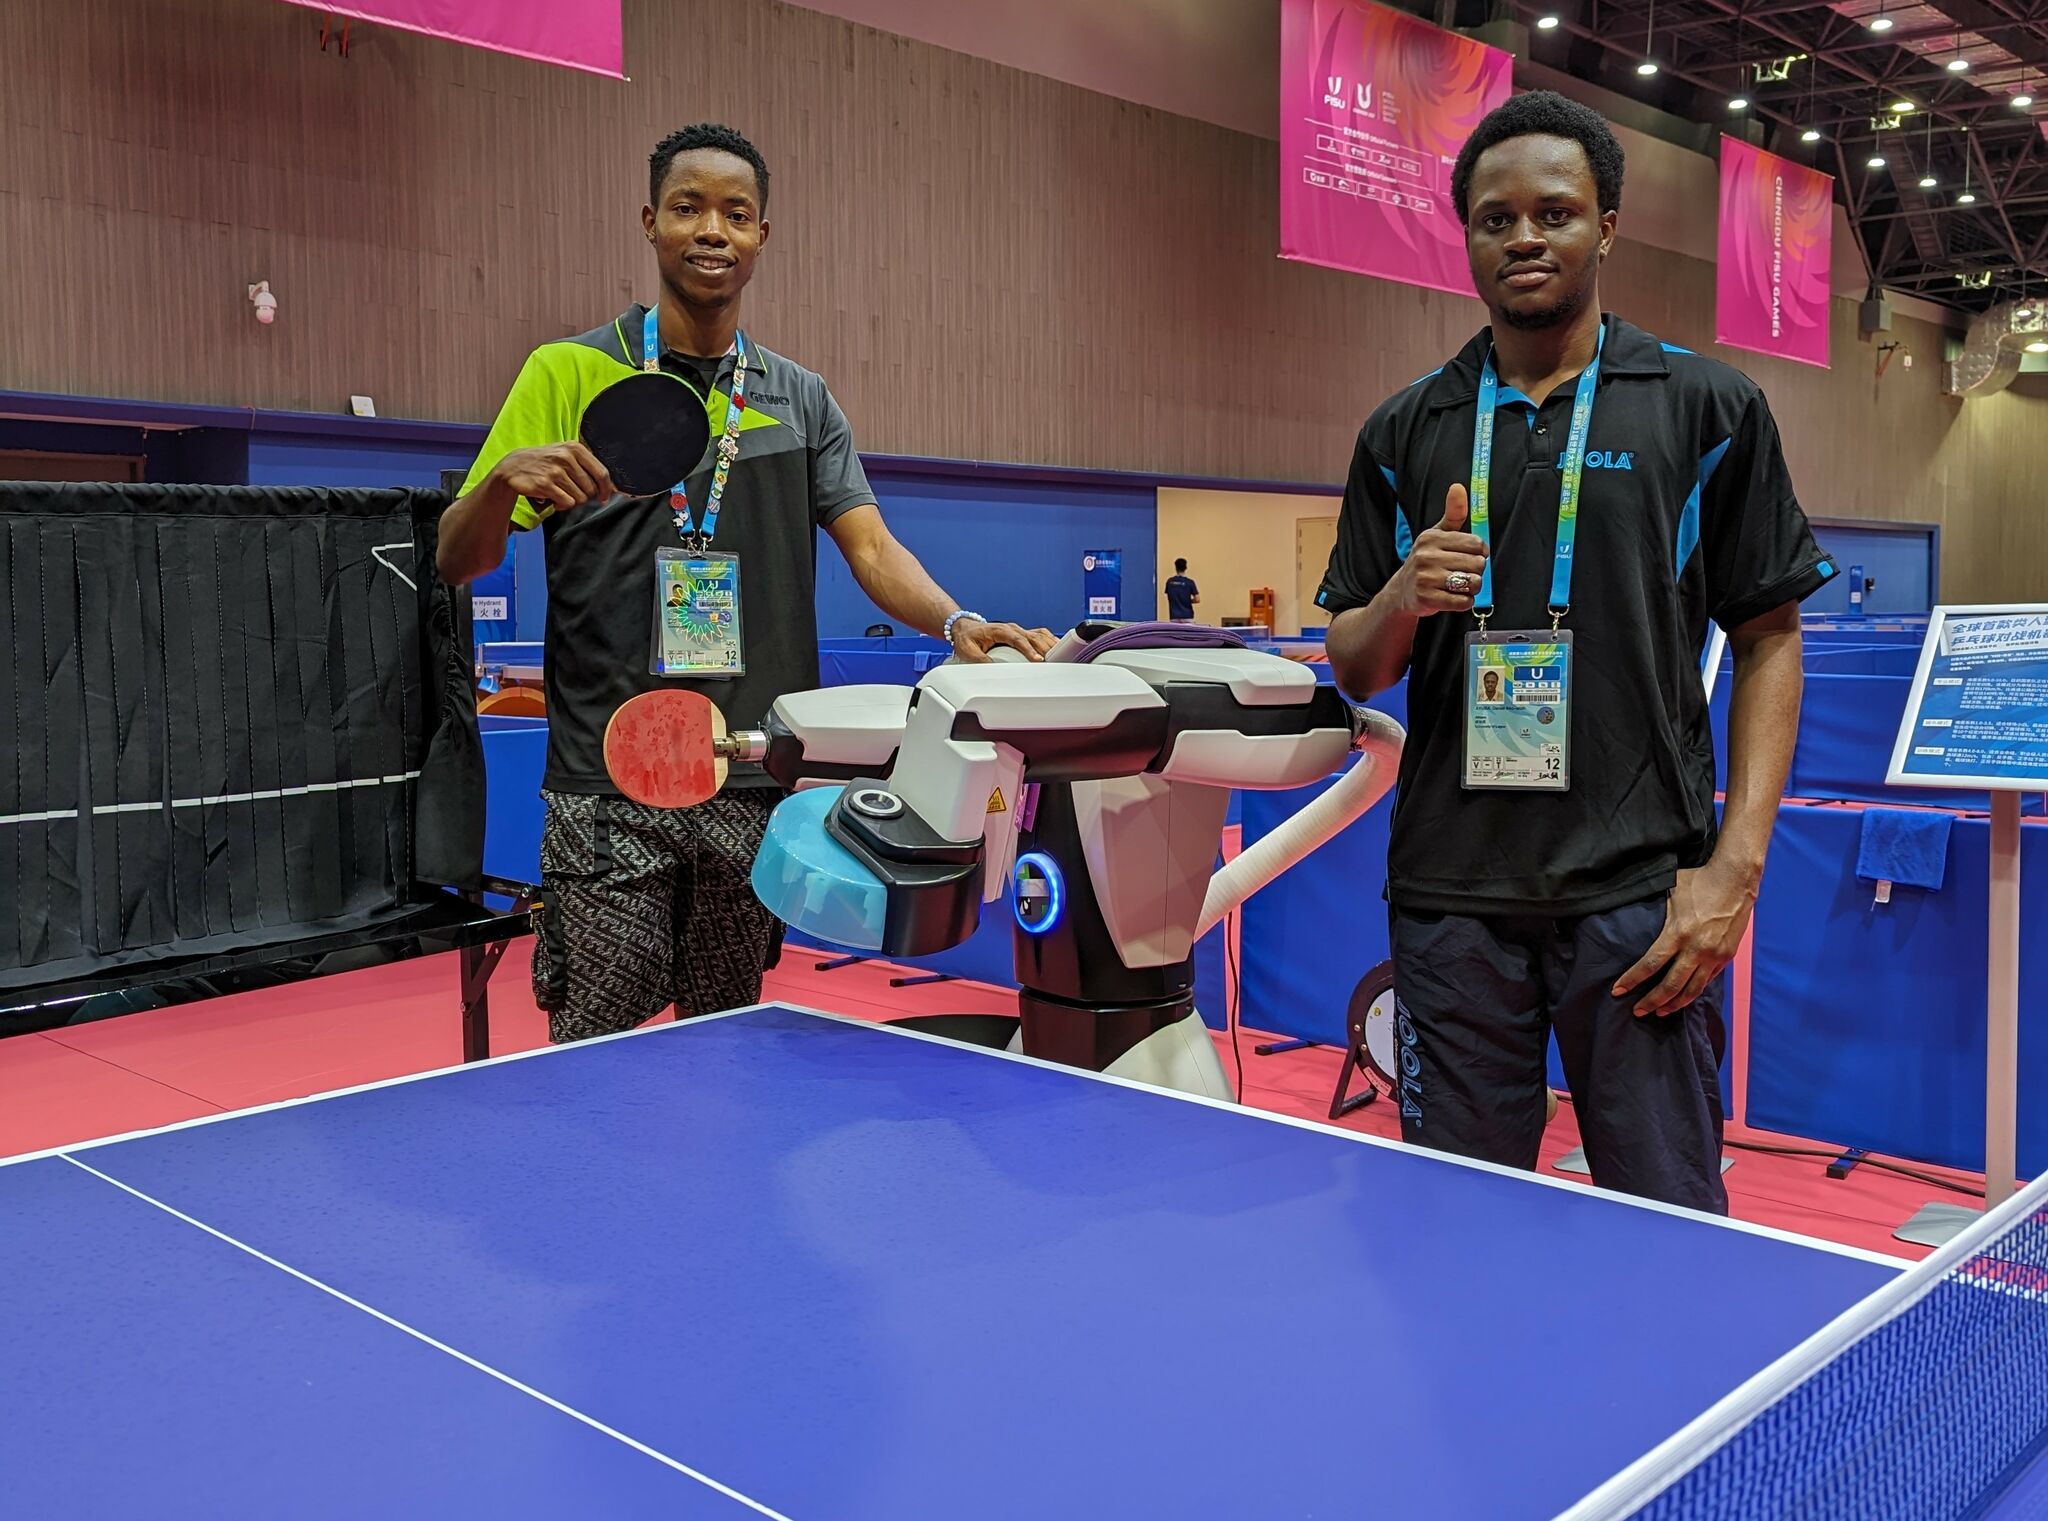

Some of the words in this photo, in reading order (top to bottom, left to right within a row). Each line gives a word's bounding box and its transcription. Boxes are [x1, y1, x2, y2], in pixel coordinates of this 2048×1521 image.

[1324, 94, 1346, 109] FISU
[1774, 176, 1783, 247] CHENGDU
[1773, 251, 1782, 283] FISU
[1772, 286, 1781, 338] GAMES
[750, 391, 790, 405] GEWO
[1556, 451, 1632, 470] JOLA
[473, 608, 501, 617] 火栓
[725, 650, 737, 660] 12
[1531, 668, 1543, 679] U
[1545, 758, 1560, 770] 12
[1397, 996, 1422, 1118] JOOLA
